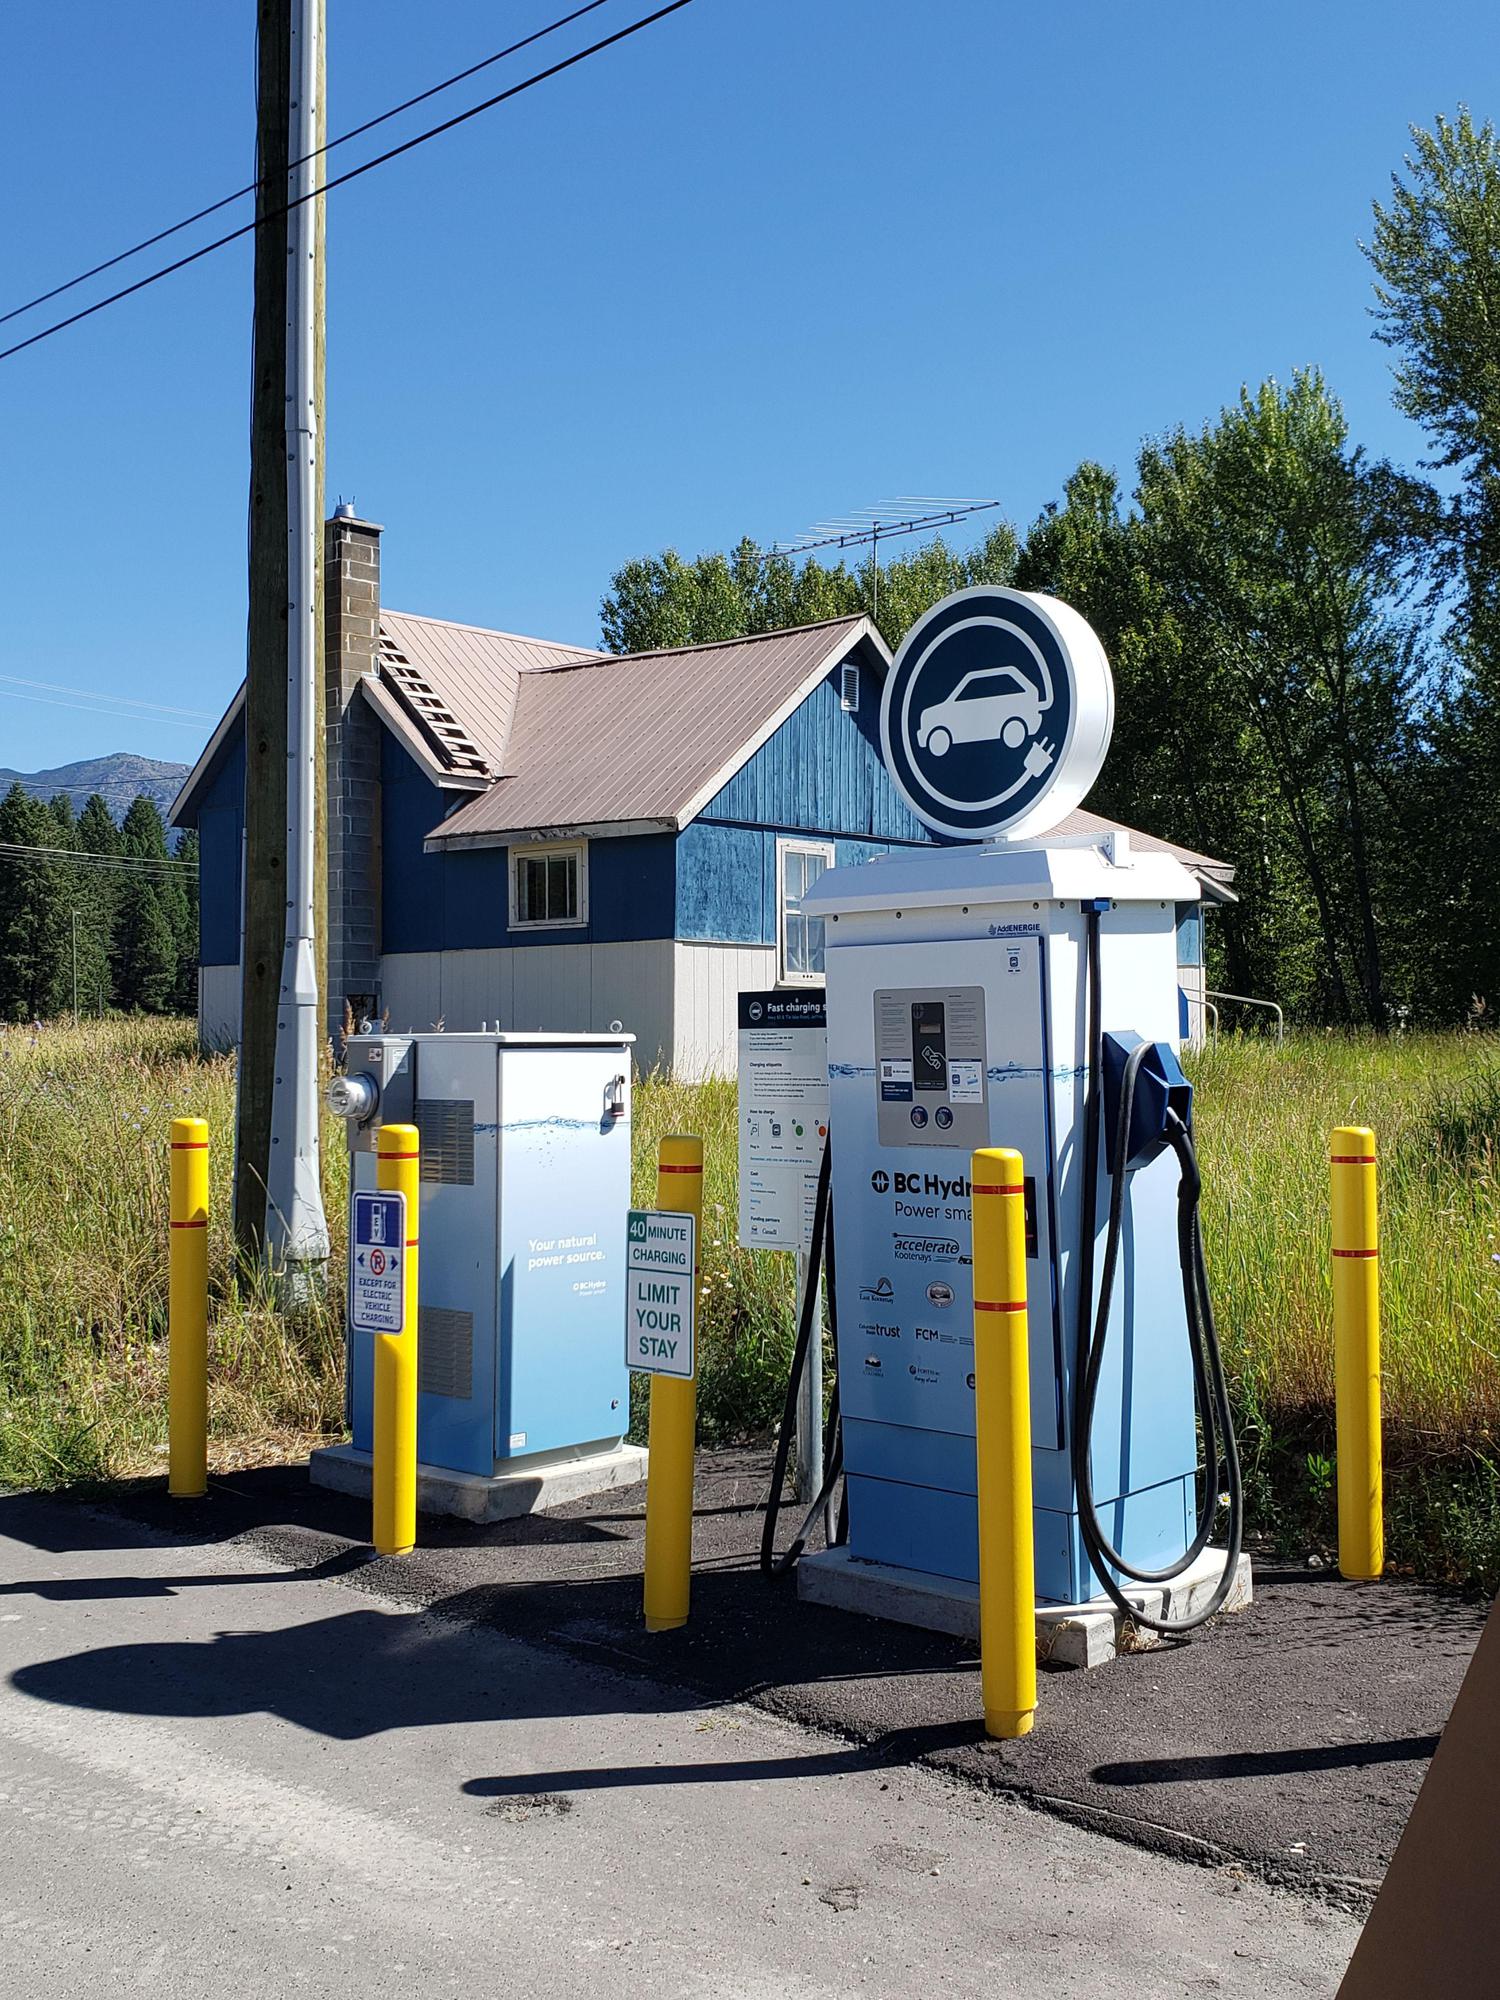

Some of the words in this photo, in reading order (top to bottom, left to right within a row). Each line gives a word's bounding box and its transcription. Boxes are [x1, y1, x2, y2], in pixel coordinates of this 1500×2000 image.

[767, 1003, 784, 1013] Fast
[786, 1001, 820, 1014] charging
[894, 1172, 921, 1194] BC
[924, 1174, 972, 1200] Hydr
[895, 1201, 940, 1219] Power
[944, 1207, 972, 1221] sma
[629, 1220, 646, 1238] 40
[648, 1225, 687, 1241] MINUTE
[528, 1239, 555, 1253] Your
[558, 1232, 597, 1249] natural
[894, 1239, 959, 1255] accelerate
[528, 1254, 565, 1271] power
[566, 1250, 606, 1264] source.
[632, 1248, 687, 1265] CHARGING
[894, 1251, 932, 1264] Kootenays
[362, 1289, 393, 1301] ELECTRIC
[638, 1282, 680, 1305] LIMIT
[364, 1301, 392, 1312] VEHICLE
[361, 1312, 394, 1325] CHARGING
[636, 1308, 681, 1333] YOUR
[875, 1323, 901, 1338] trust
[915, 1328, 939, 1341] FCM
[639, 1336, 678, 1359] STAY
